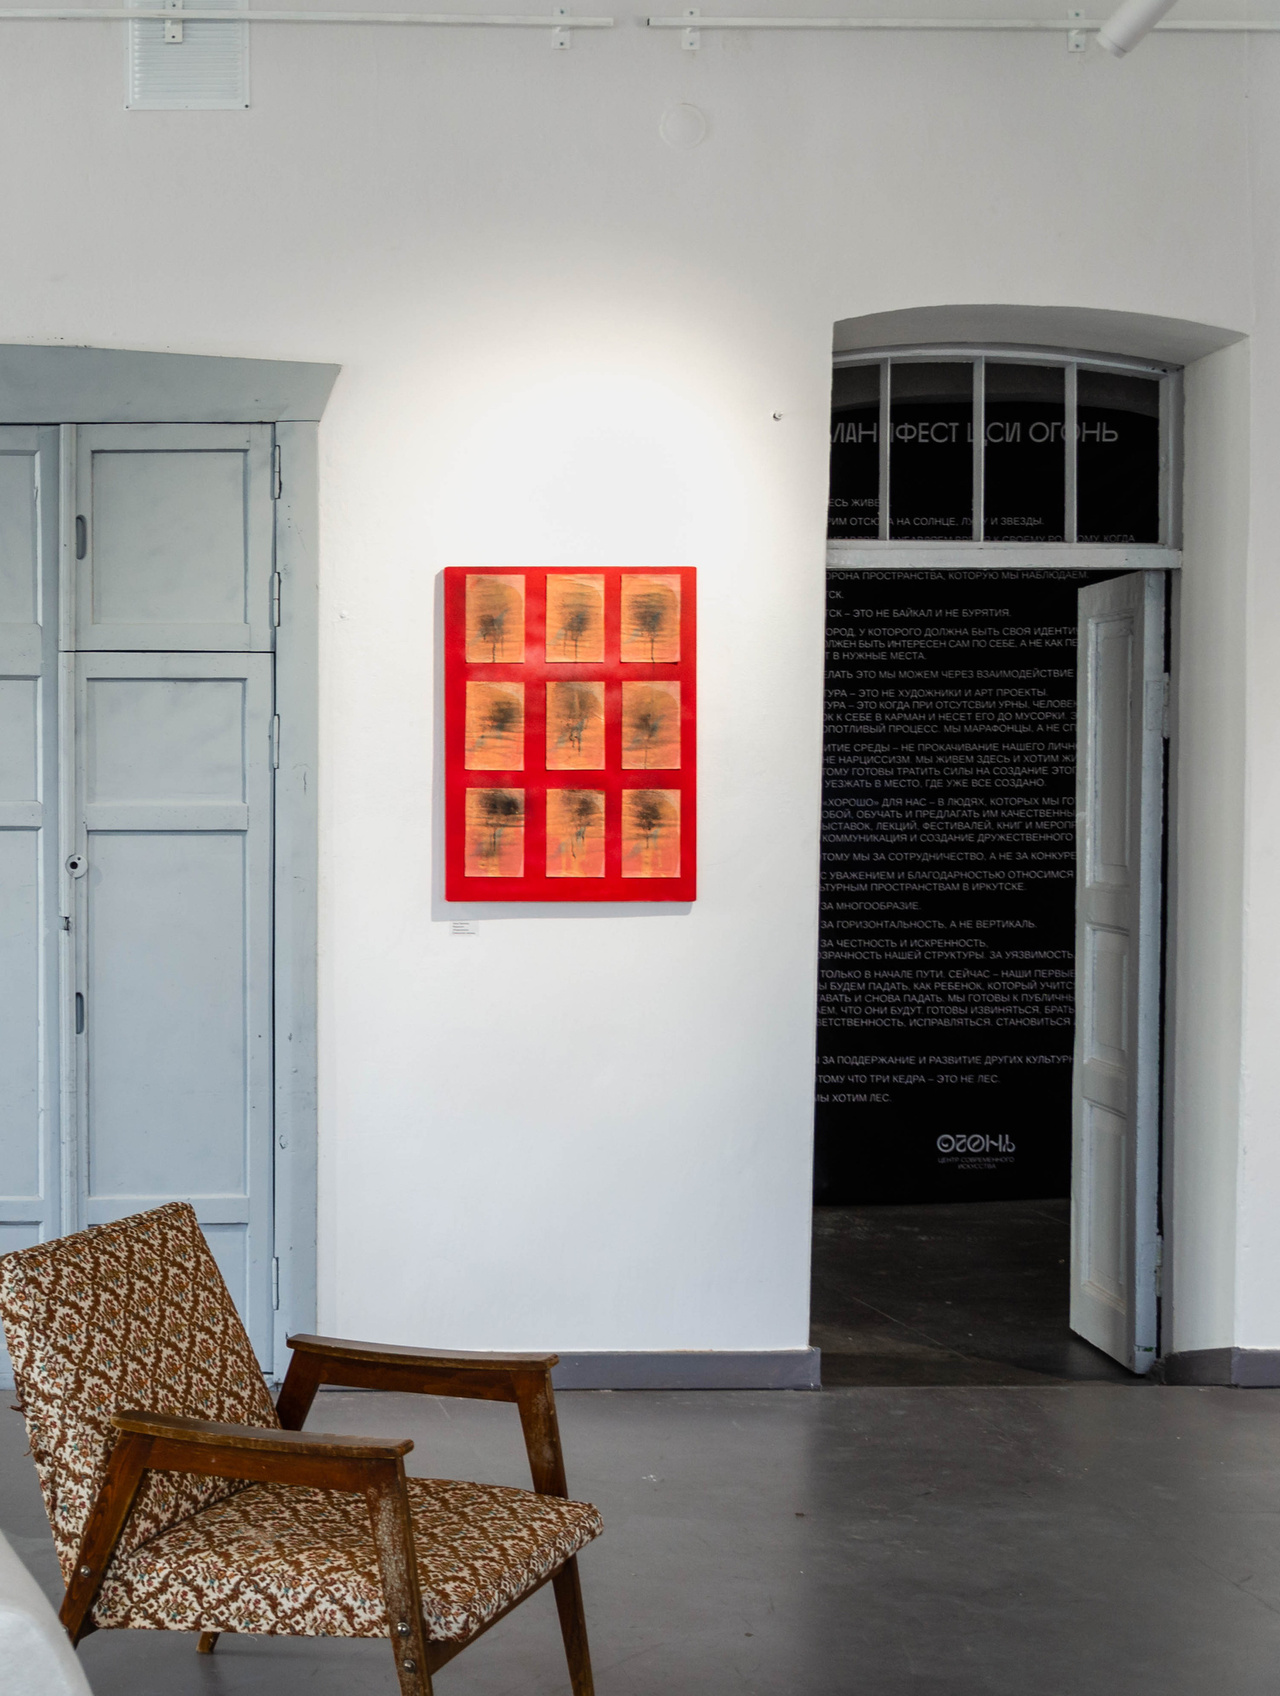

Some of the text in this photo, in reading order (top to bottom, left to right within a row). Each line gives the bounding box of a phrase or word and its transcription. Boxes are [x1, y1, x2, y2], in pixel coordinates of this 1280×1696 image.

[897, 517, 910, 526] НА
[948, 569, 999, 579] КОТОРУЮ
[852, 608, 874, 617] ЭТО
[892, 608, 933, 617] БАЙКАЛ
[867, 626, 1031, 636] КОТОРОГО ДОЛЖНА БЫТЬ СВОЯ
[857, 639, 886, 648] БЫТЬ
[886, 639, 947, 648] ИНТЕРЕСЕН
[947, 639, 970, 648] САМ
[1044, 638, 1063, 646] КАК
[841, 651, 888, 660] НУЖНЫЕ
[855, 668, 1074, 678] ЭТО МОЖЕМ ЧЕРЕЗ ВЗАИМОДЕЙСТВИЕ
[857, 688, 880, 697] ЭТО
[897, 688, 962, 697] ХУДОЖНИКИ
[973, 688, 994, 696] АРТ
[856, 700, 878, 709] ЭТО
[878, 700, 911, 710] КОГДА
[911, 700, 934, 709] ПРИ
[844, 712, 873, 721] СЕБЕ
[884, 712, 926, 720] КАРМАН
[937, 712, 973, 721] НЕСЕТ
[974, 712, 995, 721] ЕГО
[852, 742, 1046, 753] СРЕДЫ ПРОКАЧИВАНИЕ НАШЕГО
[935, 754, 975, 763] ЖИВЕМ
[976, 754, 1011, 764] ЗДЕСЬ
[1022, 754, 1060, 762] ХОТИМ
[851, 766, 1049, 776] ГОТОВЫ ТРАТИТЬ СИЛЫ СОЗДАНИЕ
[824, 779, 873, 788] УЕЗЖАТЬ
[924, 778, 943, 788] ГДЕ
[945, 778, 969, 787] УЖЕ
[970, 778, 992, 787] ВСЕ
[880, 797, 903, 807] ДЛЯ
[904, 797, 927, 806] НАС
[989, 797, 1040, 805] КОТОРЫХ
[855, 809, 980, 818] ОБУЧАТЬ ПРЕДЛАГАТЬ
[996, 821, 1023, 829] КНИГ
[822, 832, 1074, 842] КОММУНИКАЦИЯ СОЗДАНИЕ ДРУЖЕСТВЕННОГО
[828, 870, 1074, 879] УВАЖЕНИЕМ БЛАГОДАРНОСТЬЮ ОТНОСИМСЯ
[870, 882, 960, 891] ПРОСТРАНСТВАМ
[835, 938, 898, 947] ЧЕСТНОСТЬ
[884, 949, 922, 959] НАШЕЙ
[821, 969, 1032, 978] ТОЛЬКО НАЧАЛЕ СЕЙЧАС НАШИ
[829, 981, 866, 991] БУДЕМ
[912, 982, 932, 990] КАК
[986, 980, 1038, 990] КОТОРЫЙ
[863, 993, 1011, 1002] СНОВА ГОТОВЫ
[840, 1005, 863, 1014] ЧТО
[863, 1005, 888, 1014] ОНИ
[926, 1005, 968, 1014] ГОТОВЫ
[995, 1017, 1071, 1026] СТАНОВИТЬСЯ
[836, 1055, 1023, 1065] ПОДДЕРЖАНИЕ РАЗВИТИЕ ДРУГИХ
[847, 1074, 868, 1083] ЧТО
[869, 1074, 890, 1082] ТРИ
[891, 1074, 926, 1084] КЕДРА
[936, 1074, 958, 1083] ЭТО
[831, 1093, 868, 1102] ХОТИМ
